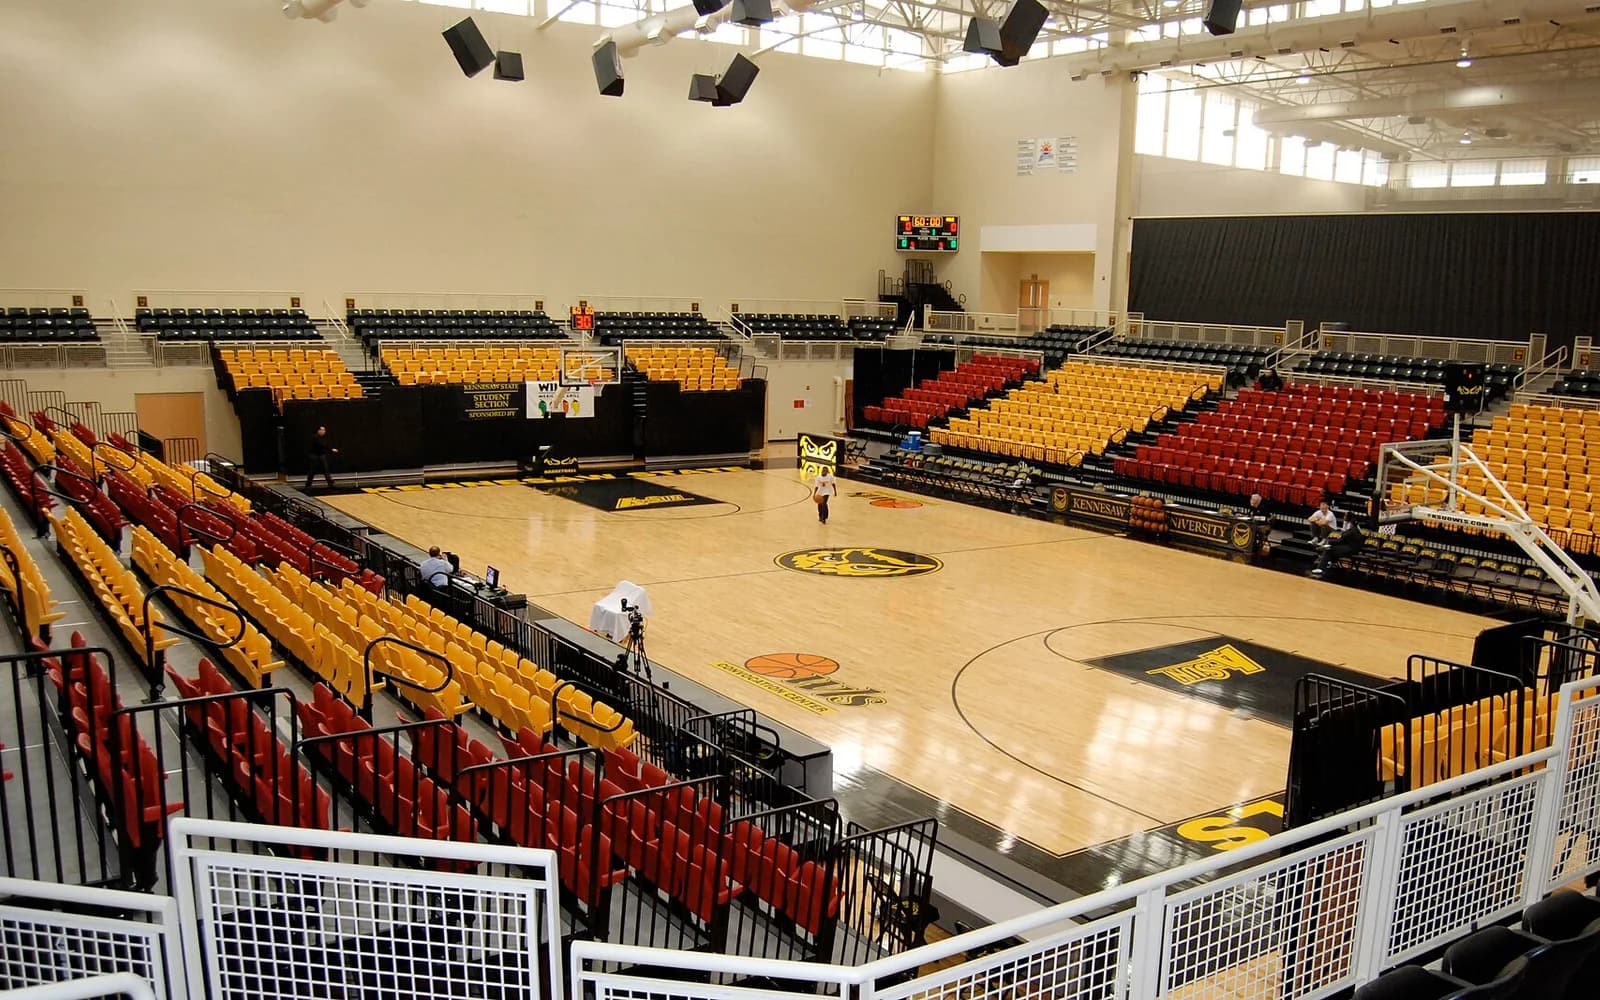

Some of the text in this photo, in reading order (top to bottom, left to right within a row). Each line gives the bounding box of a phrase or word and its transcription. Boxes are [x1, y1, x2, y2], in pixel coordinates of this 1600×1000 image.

[915, 217, 941, 226] 60:00
[575, 316, 592, 328] 30
[473, 394, 511, 402] STUDENT
[475, 401, 509, 409] SECTION
[1073, 497, 1227, 538] KENNESAW NIVERSITY
[717, 662, 830, 714] CONVOCATION CENTER
